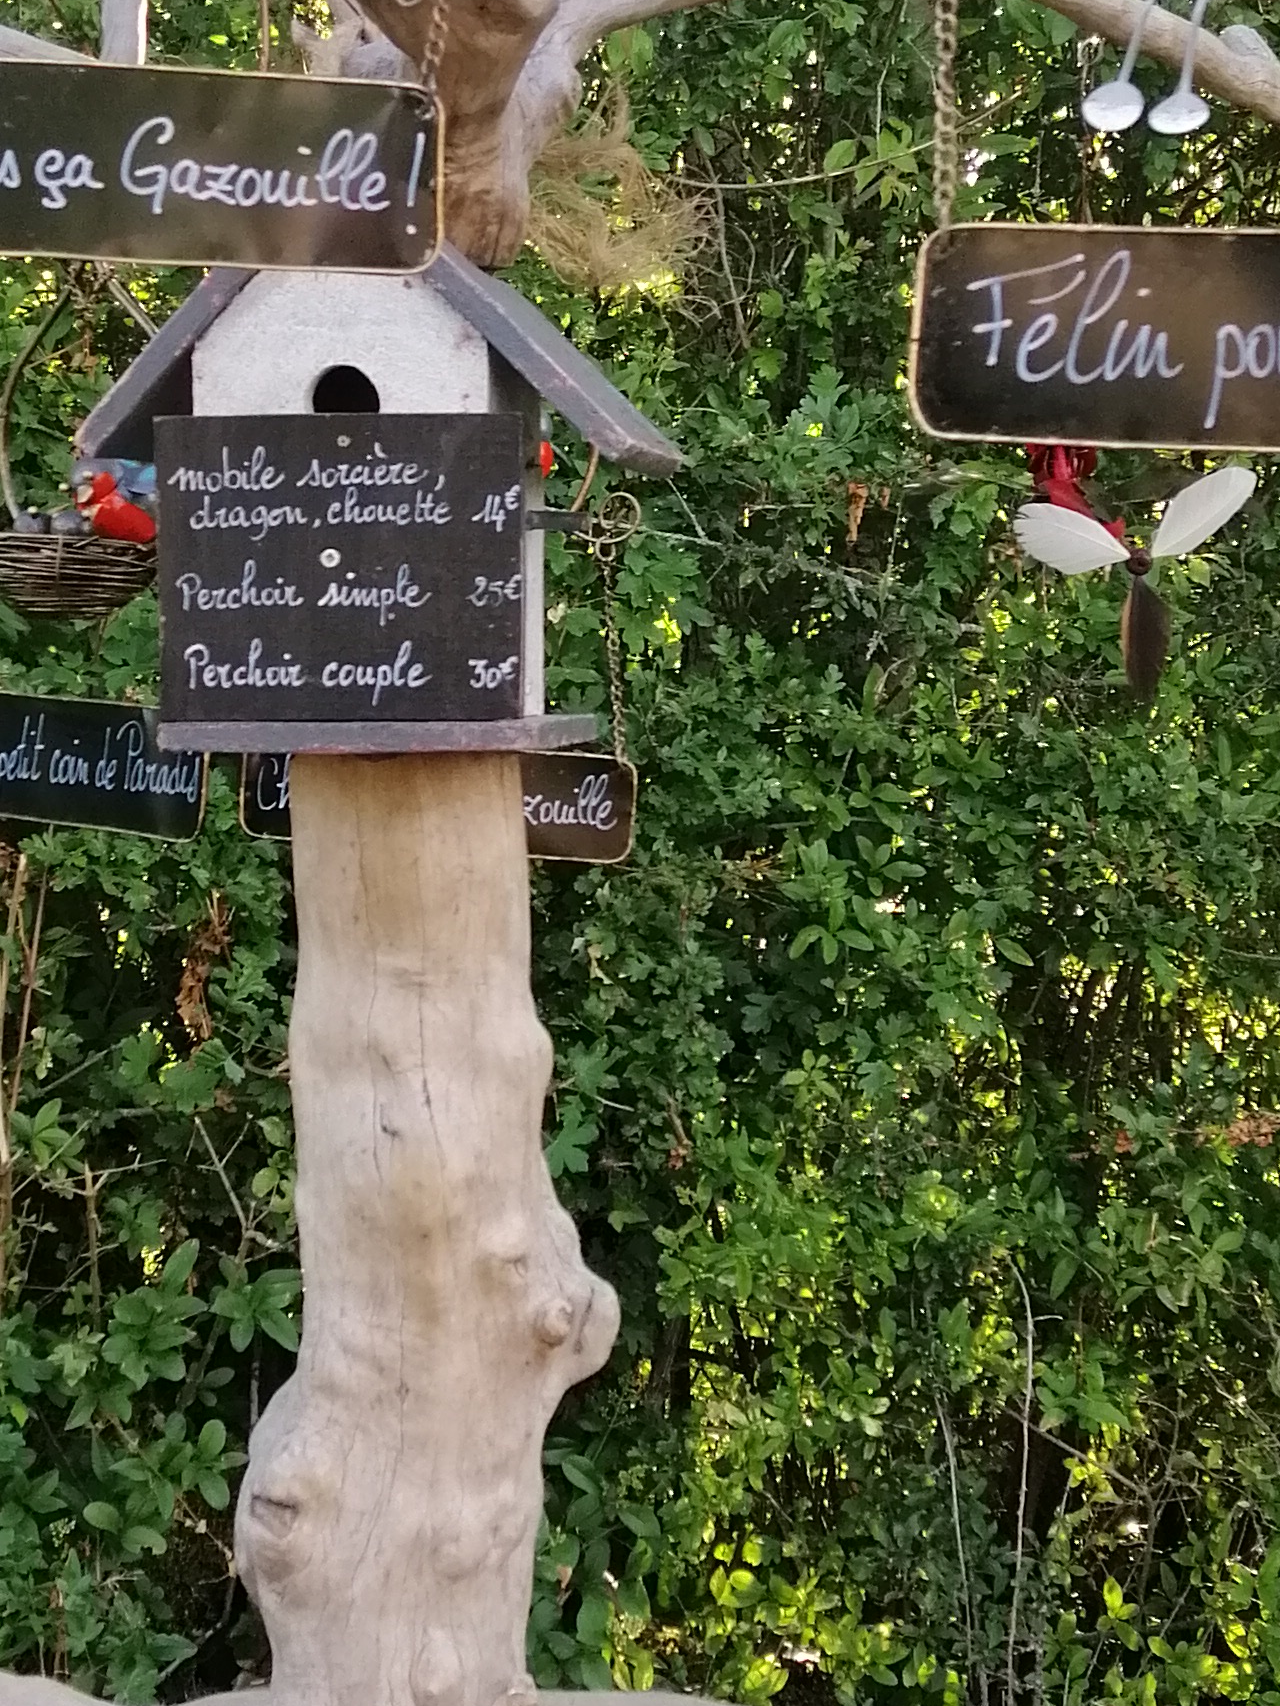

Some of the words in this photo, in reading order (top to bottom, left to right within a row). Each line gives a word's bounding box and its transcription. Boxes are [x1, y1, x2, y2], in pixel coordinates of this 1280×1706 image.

[34, 148, 105, 209] ça
[121, 116, 392, 213] Gazouille
[966, 249, 1185, 385] Félin
[167, 445, 285, 492] mobile
[326, 486, 452, 525] chouette
[471, 483, 521, 533] 14€
[175, 559, 304, 611] Perchoir
[317, 564, 432, 626] simple
[466, 574, 522, 607] 25€
[184, 638, 306, 690] Perchoir
[320, 639, 433, 707] couple
[468, 654, 519, 689] 30€
[49, 738, 89, 786] coin
[95, 727, 118, 791] de
[117, 720, 201, 804] Paradis
